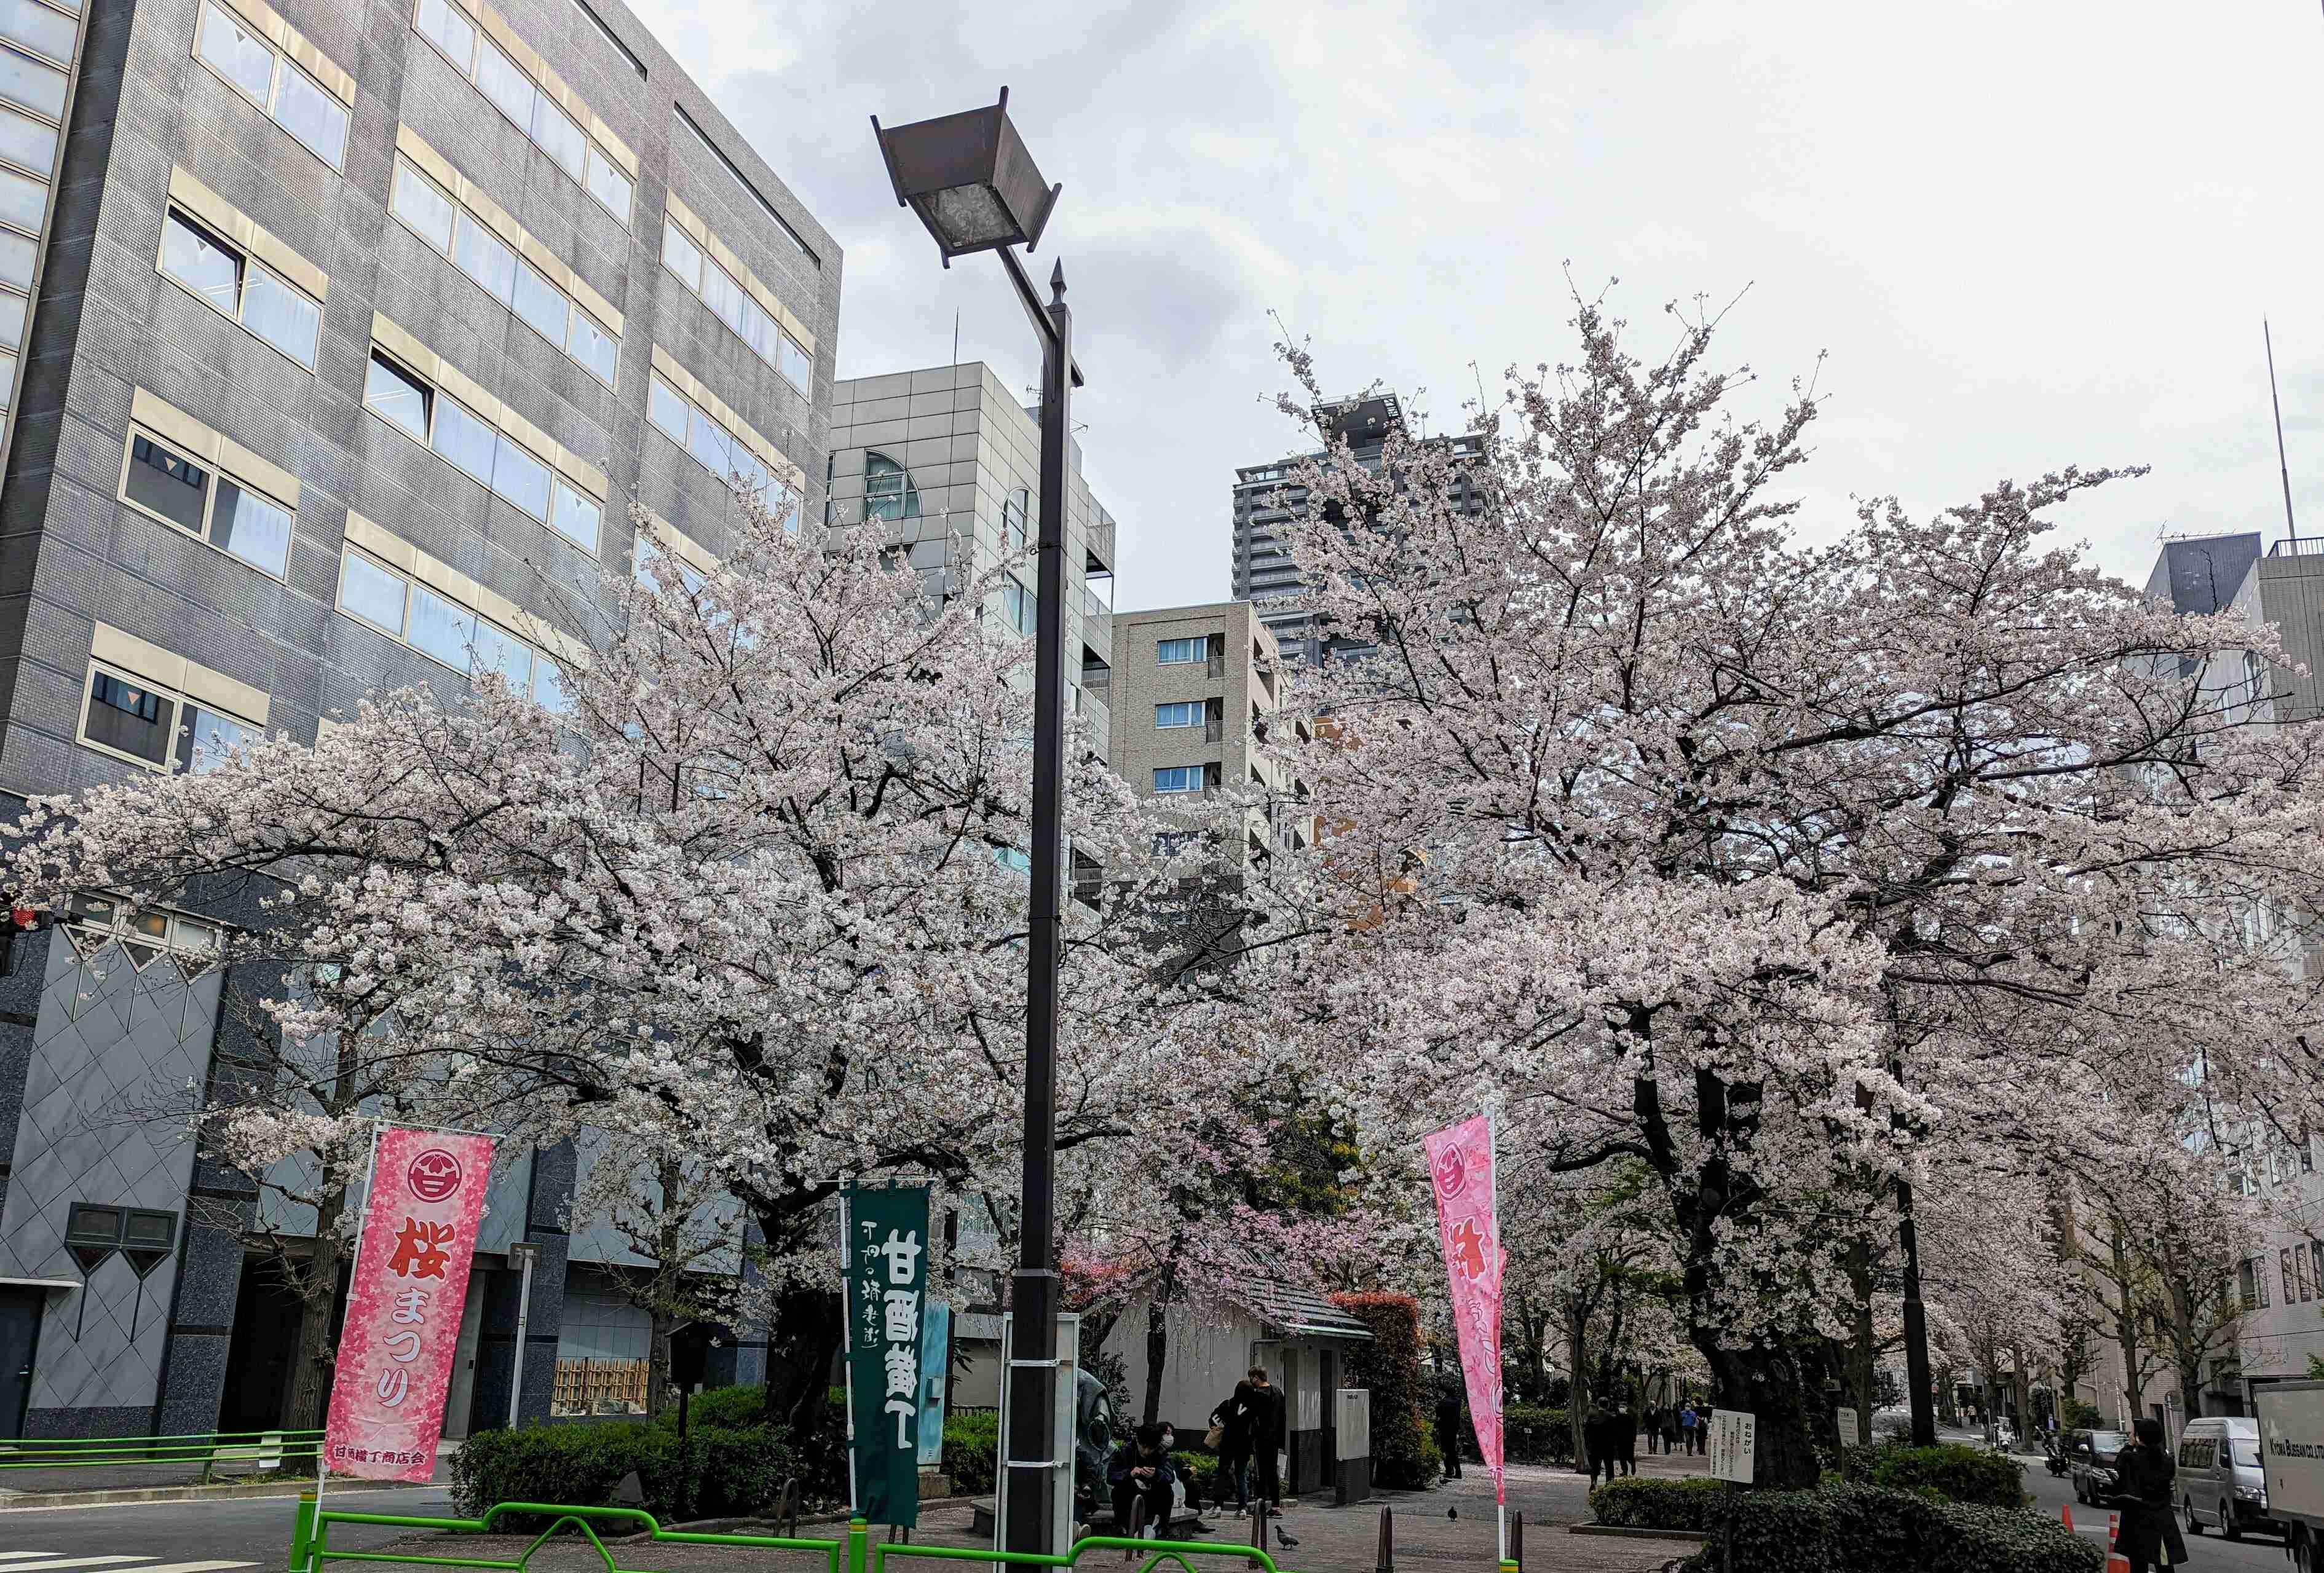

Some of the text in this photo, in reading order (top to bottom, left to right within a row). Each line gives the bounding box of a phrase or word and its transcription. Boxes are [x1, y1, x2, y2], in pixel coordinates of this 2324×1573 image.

[377, 1216, 456, 1408] 桜まつり
[334, 1445, 425, 1465] 甘酒横丁商店会
